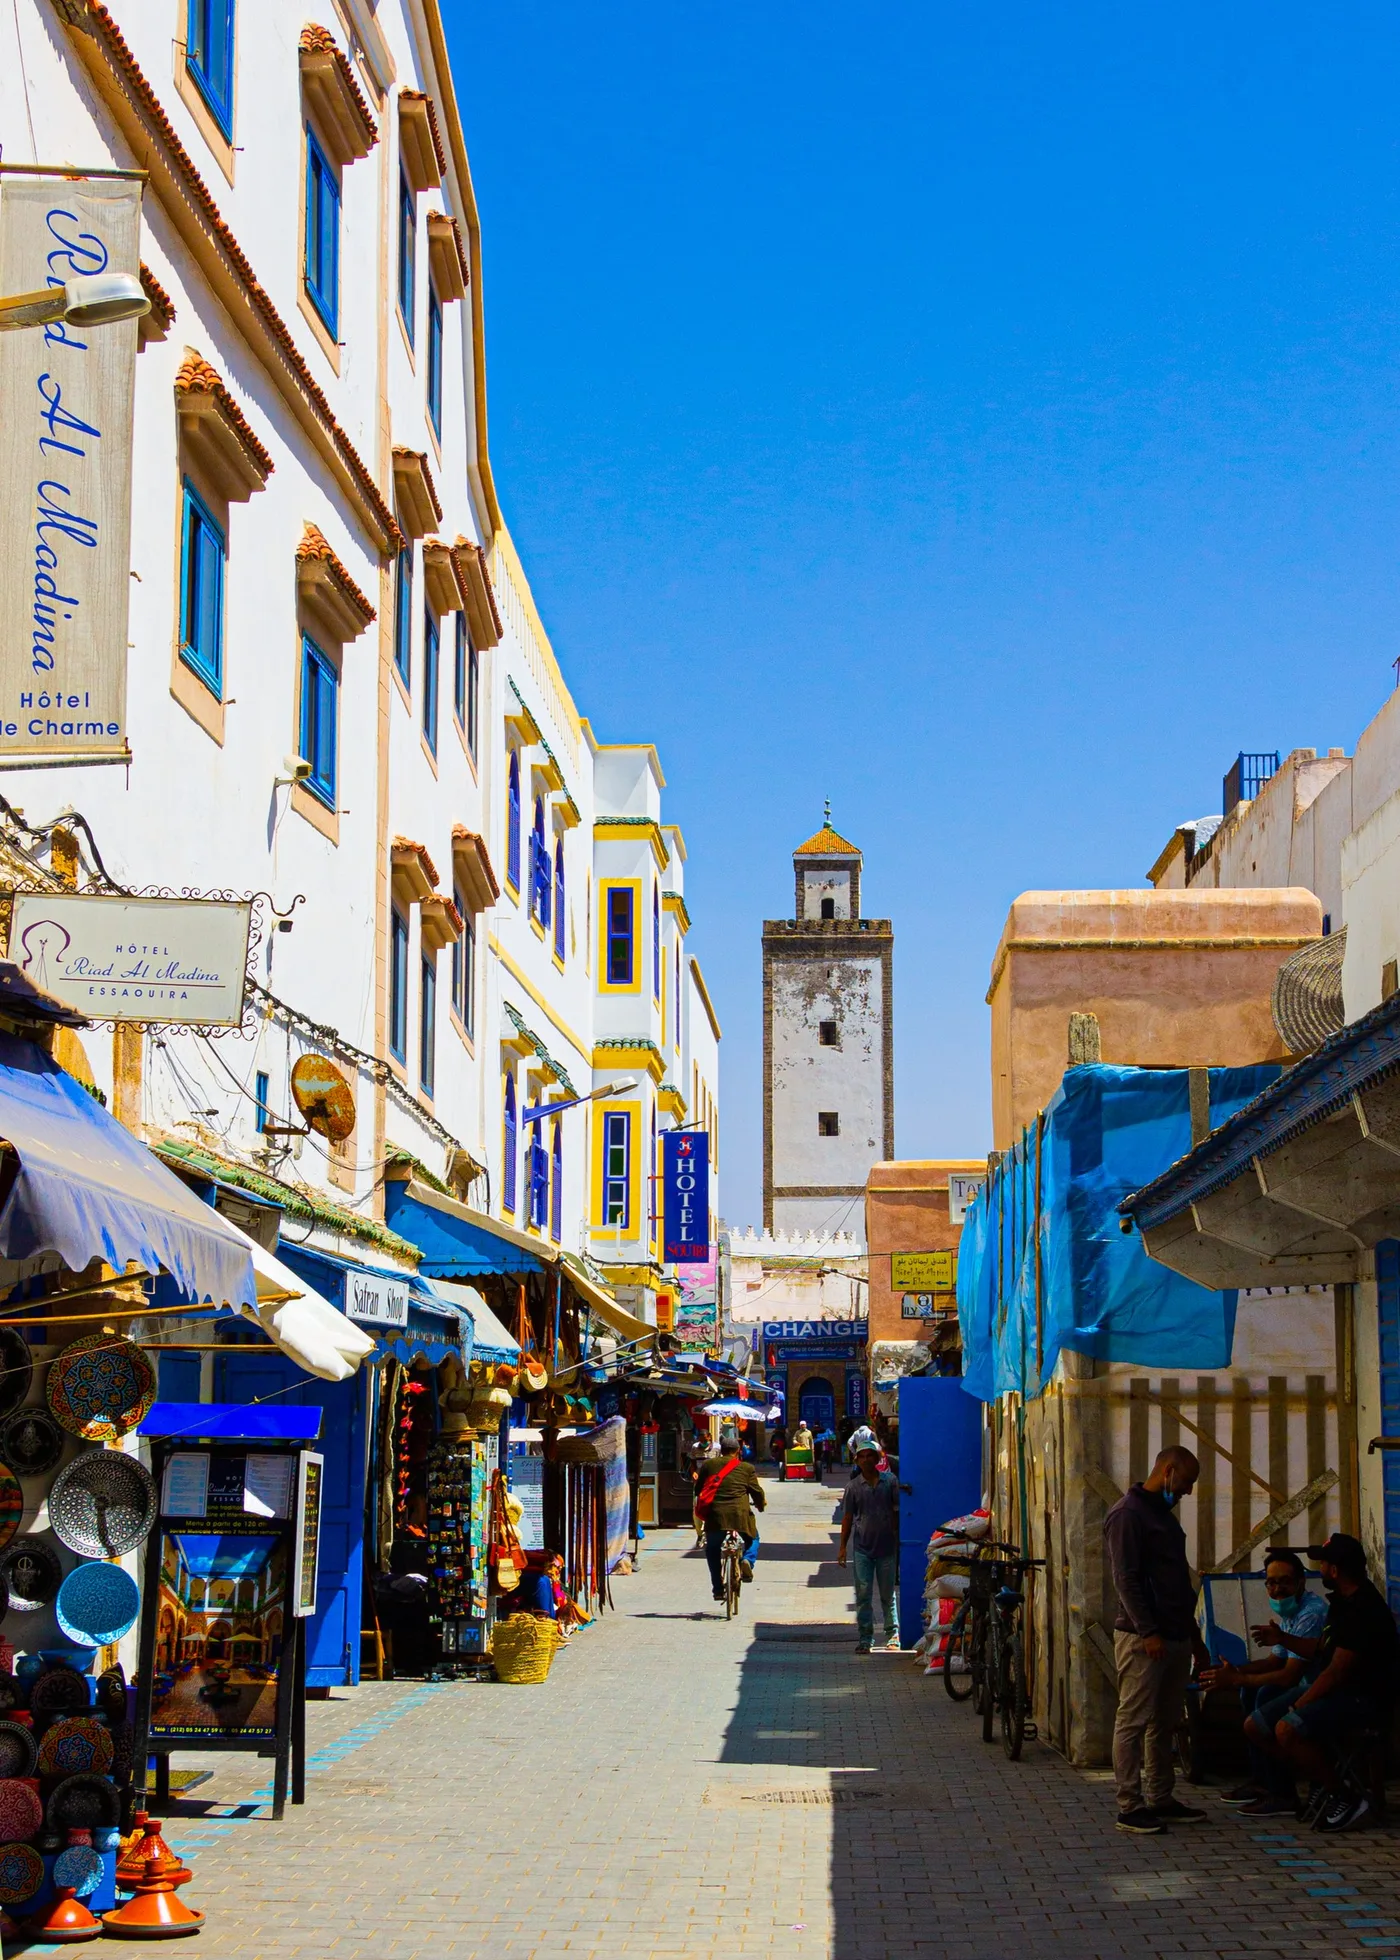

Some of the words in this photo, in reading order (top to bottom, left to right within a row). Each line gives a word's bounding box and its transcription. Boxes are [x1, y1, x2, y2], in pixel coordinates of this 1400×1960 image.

[44, 209, 108, 350] Rid
[38, 372, 101, 457] Al
[32, 480, 98, 676] Madina
[20, 690, 89, 708] Hôtel
[0, 720, 18, 736] e
[28, 719, 119, 736] Charme
[116, 943, 169, 956] HÔTEL
[65, 956, 113, 977] Riad
[120, 960, 150, 979] Al
[156, 961, 220, 981] Madina
[89, 986, 189, 1000] ESSAOUIRA
[676, 1158, 696, 1242] HOTEL
[353, 1280, 380, 1316] Safran
[385, 1287, 404, 1321] Shop
[765, 1321, 867, 1337] CHANGE
